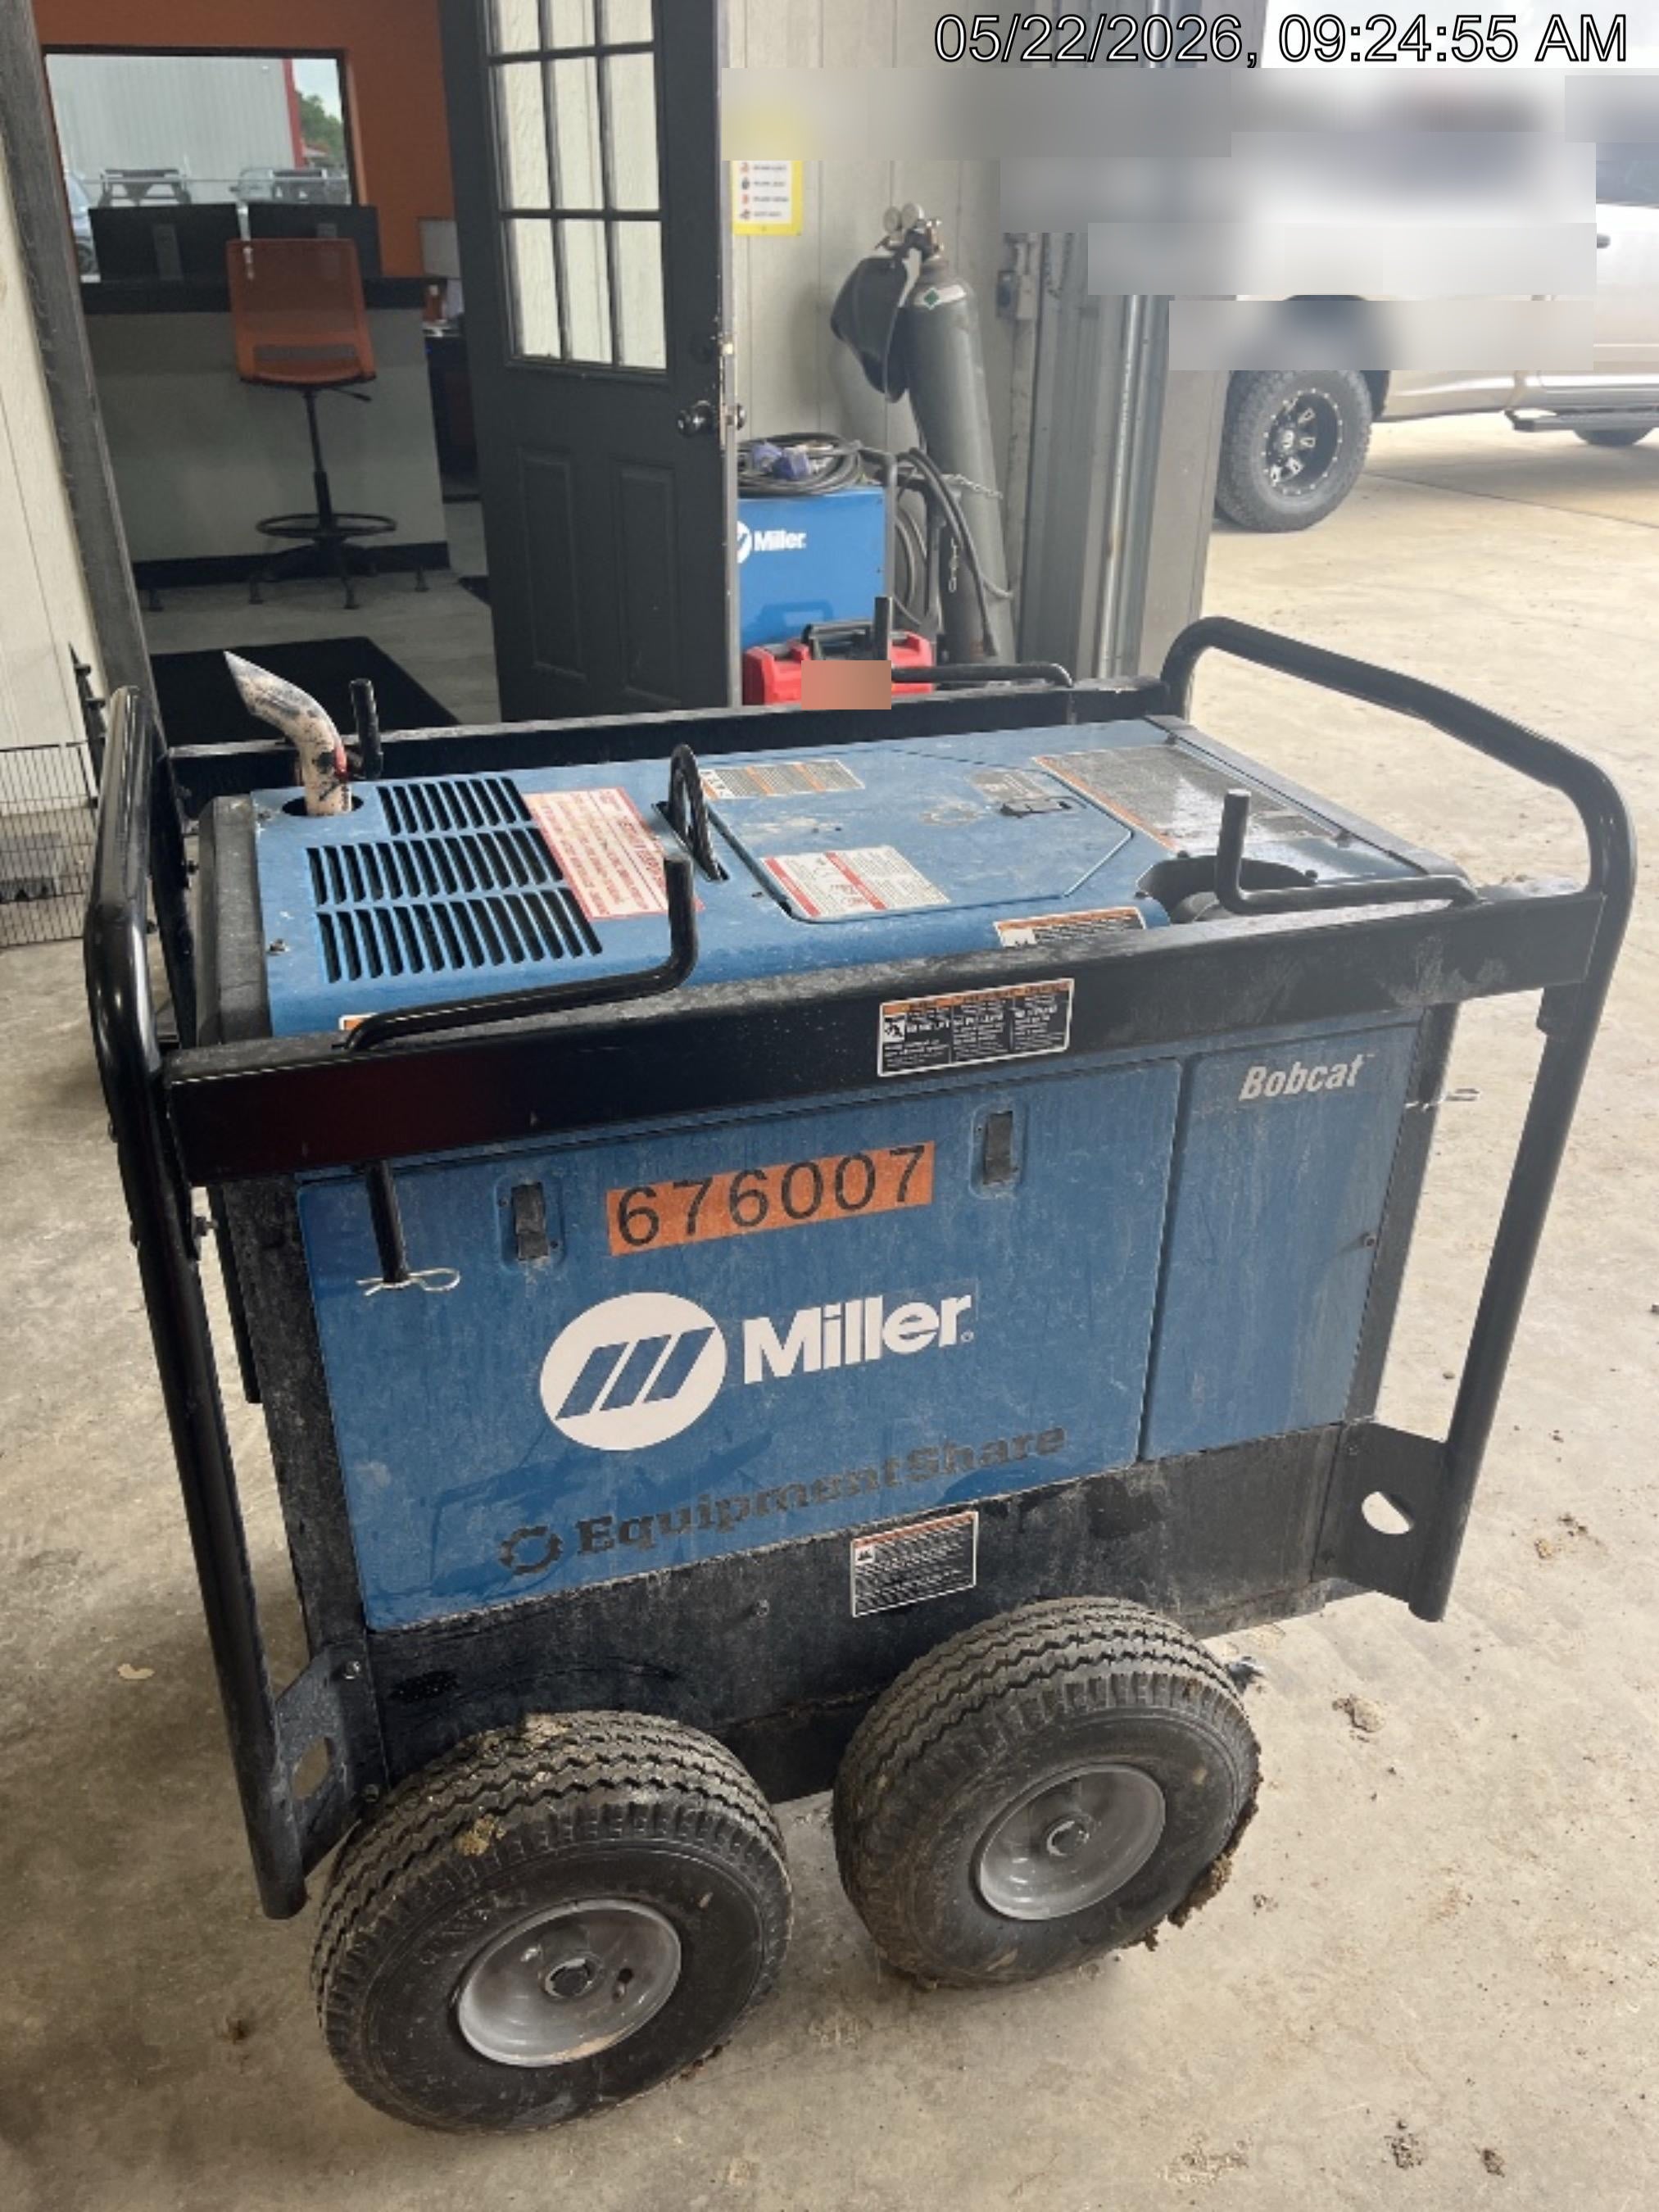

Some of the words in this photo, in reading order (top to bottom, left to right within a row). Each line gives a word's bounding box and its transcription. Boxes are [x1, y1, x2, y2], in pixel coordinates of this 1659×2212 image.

[753, 528, 807, 551] Miller
[1238, 1054, 1365, 1102] Bobcat
[618, 1145, 926, 1247] 676007
[742, 1294, 972, 1385] Miller
[576, 1426, 1066, 1555] EquipmentShare
